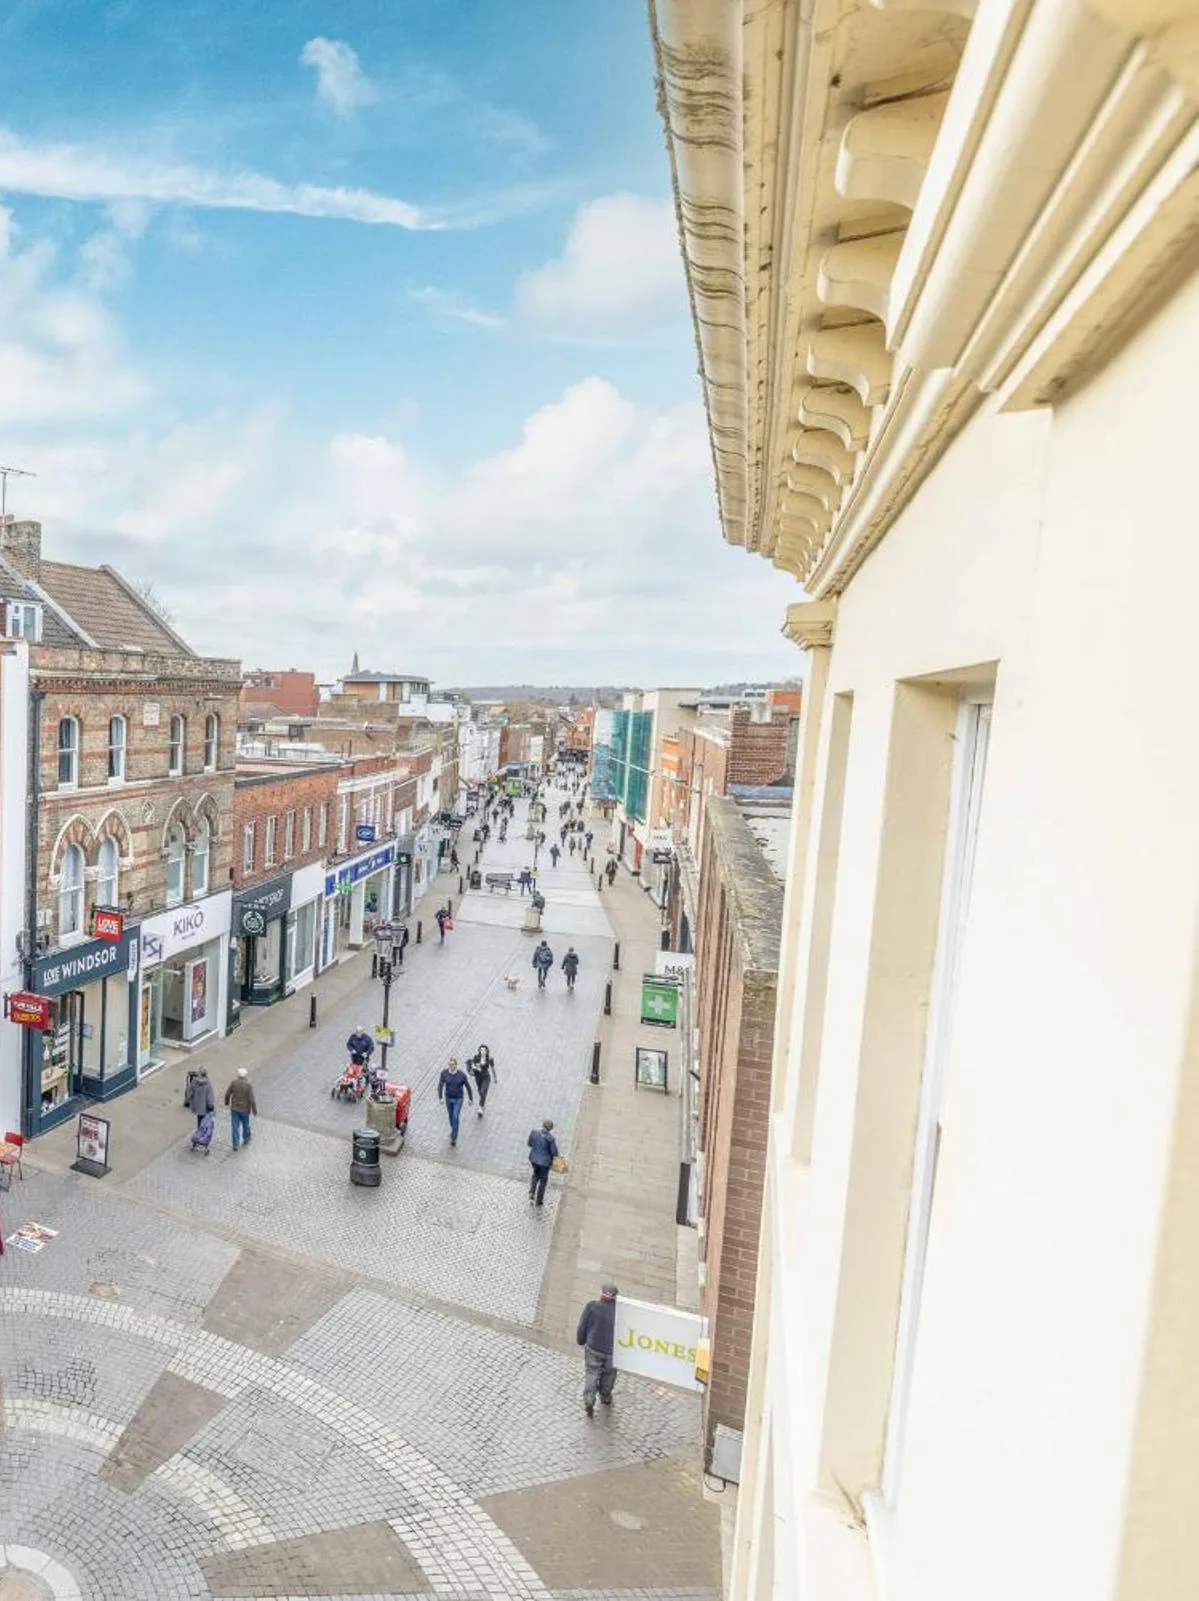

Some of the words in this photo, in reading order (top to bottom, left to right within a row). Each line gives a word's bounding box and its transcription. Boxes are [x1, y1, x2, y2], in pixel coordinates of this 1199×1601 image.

[97, 918, 119, 932] LOVE
[173, 911, 204, 936] KIKO
[61, 946, 118, 979] WINDSOR
